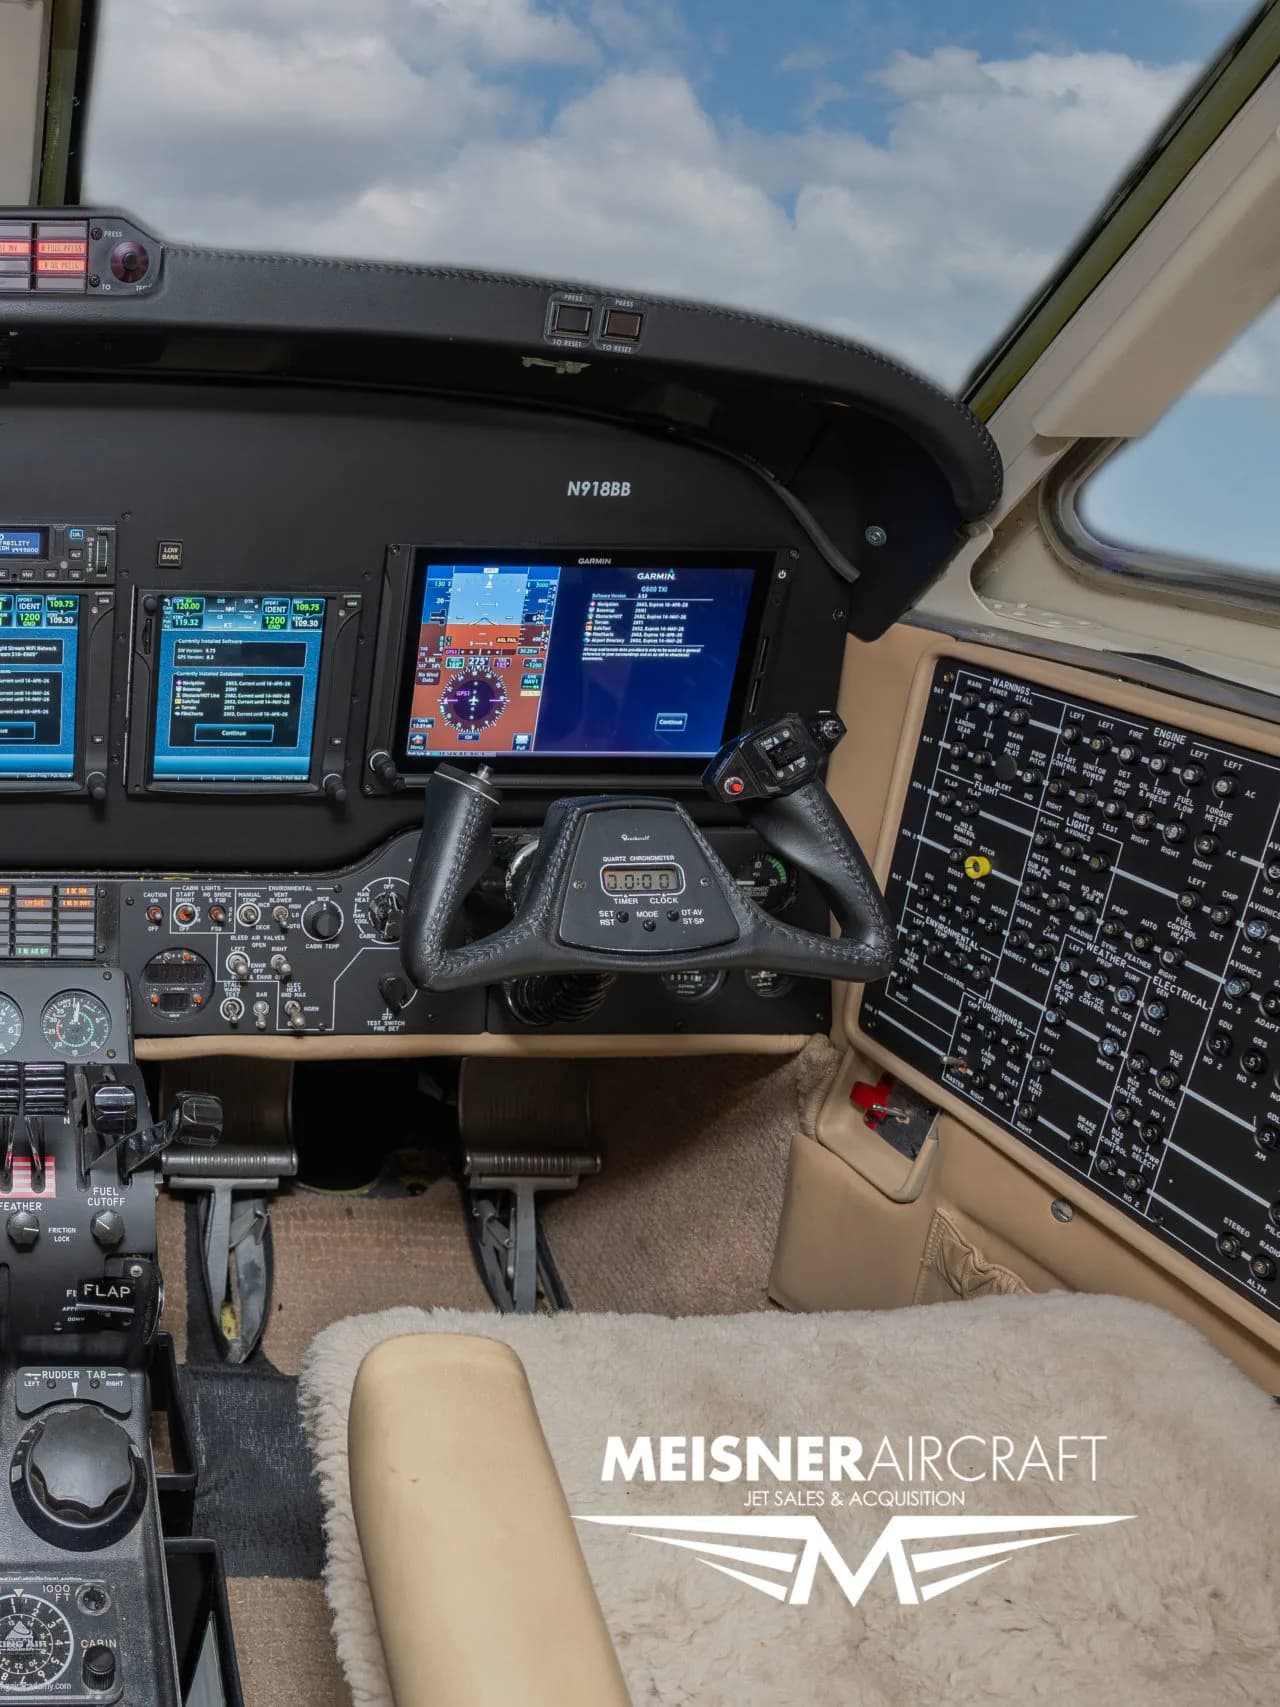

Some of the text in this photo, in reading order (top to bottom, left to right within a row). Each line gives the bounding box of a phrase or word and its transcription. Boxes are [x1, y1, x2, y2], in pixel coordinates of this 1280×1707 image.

[564, 294, 583, 302] PRESS
[615, 300, 634, 308] PRESS
[564, 340, 581, 348] RESET
[613, 345, 632, 353] RESET
[567, 480, 631, 497] N918BB
[637, 572, 675, 581] GARMIN
[50, 600, 74, 608] 109.75
[176, 602, 200, 610] 120.00
[296, 603, 319, 611] 109.75
[19, 613, 40, 621] 1200
[49, 616, 73, 624] 109.30
[175, 618, 199, 626] 119.32
[265, 616, 285, 624] 1200
[294, 619, 318, 627] 109.30
[989, 686, 1008, 698] POWER
[992, 677, 1031, 696] WARNINGS
[1015, 694, 1033, 706] STALL
[1070, 711, 1085, 721] LEFT
[1098, 720, 1115, 731] LEFT
[221, 729, 247, 737] Continue
[1128, 729, 1144, 740] FIRE
[1153, 727, 1187, 745] ENGINE
[1190, 749, 1209, 761] LEFT
[1223, 759, 1243, 771] LEFT
[974, 781, 1000, 797] FLIGHT
[1244, 790, 1257, 799] AC
[1176, 795, 1194, 807] FUEL
[1173, 802, 1194, 815] FLOW
[1206, 804, 1234, 821] TORQUE
[1066, 816, 1095, 835] LIGHTS
[1204, 813, 1229, 827] METER
[1102, 822, 1119, 834] TEST
[1192, 858, 1213, 871] RIGHT
[1187, 876, 1207, 888] LEFT
[598, 910, 614, 918] SET
[1140, 918, 1158, 930] AUTO
[925, 916, 979, 951] ENVIRONMENTAL
[1086, 942, 1127, 968] WEATHER
[1229, 959, 1263, 979] AVIONICS
[1152, 975, 1209, 1011] ELECTRICAL
[978, 998, 1023, 1029] FURNISHINGS
[1140, 1021, 1161, 1037] RESET
[93, 1187, 119, 1196] FUEL
[87, 1197, 126, 1206] CUTOFF
[1223, 1216, 1251, 1238] STEREO
[83, 1284, 131, 1298] FLAP
[1246, 1278, 1267, 1295] ALTM
[42, 1370, 107, 1379] RUDDER TAB
[42, 1585, 70, 1593] 1000
[55, 1594, 70, 1602] FT
[80, 1640, 117, 1649] CABIN
